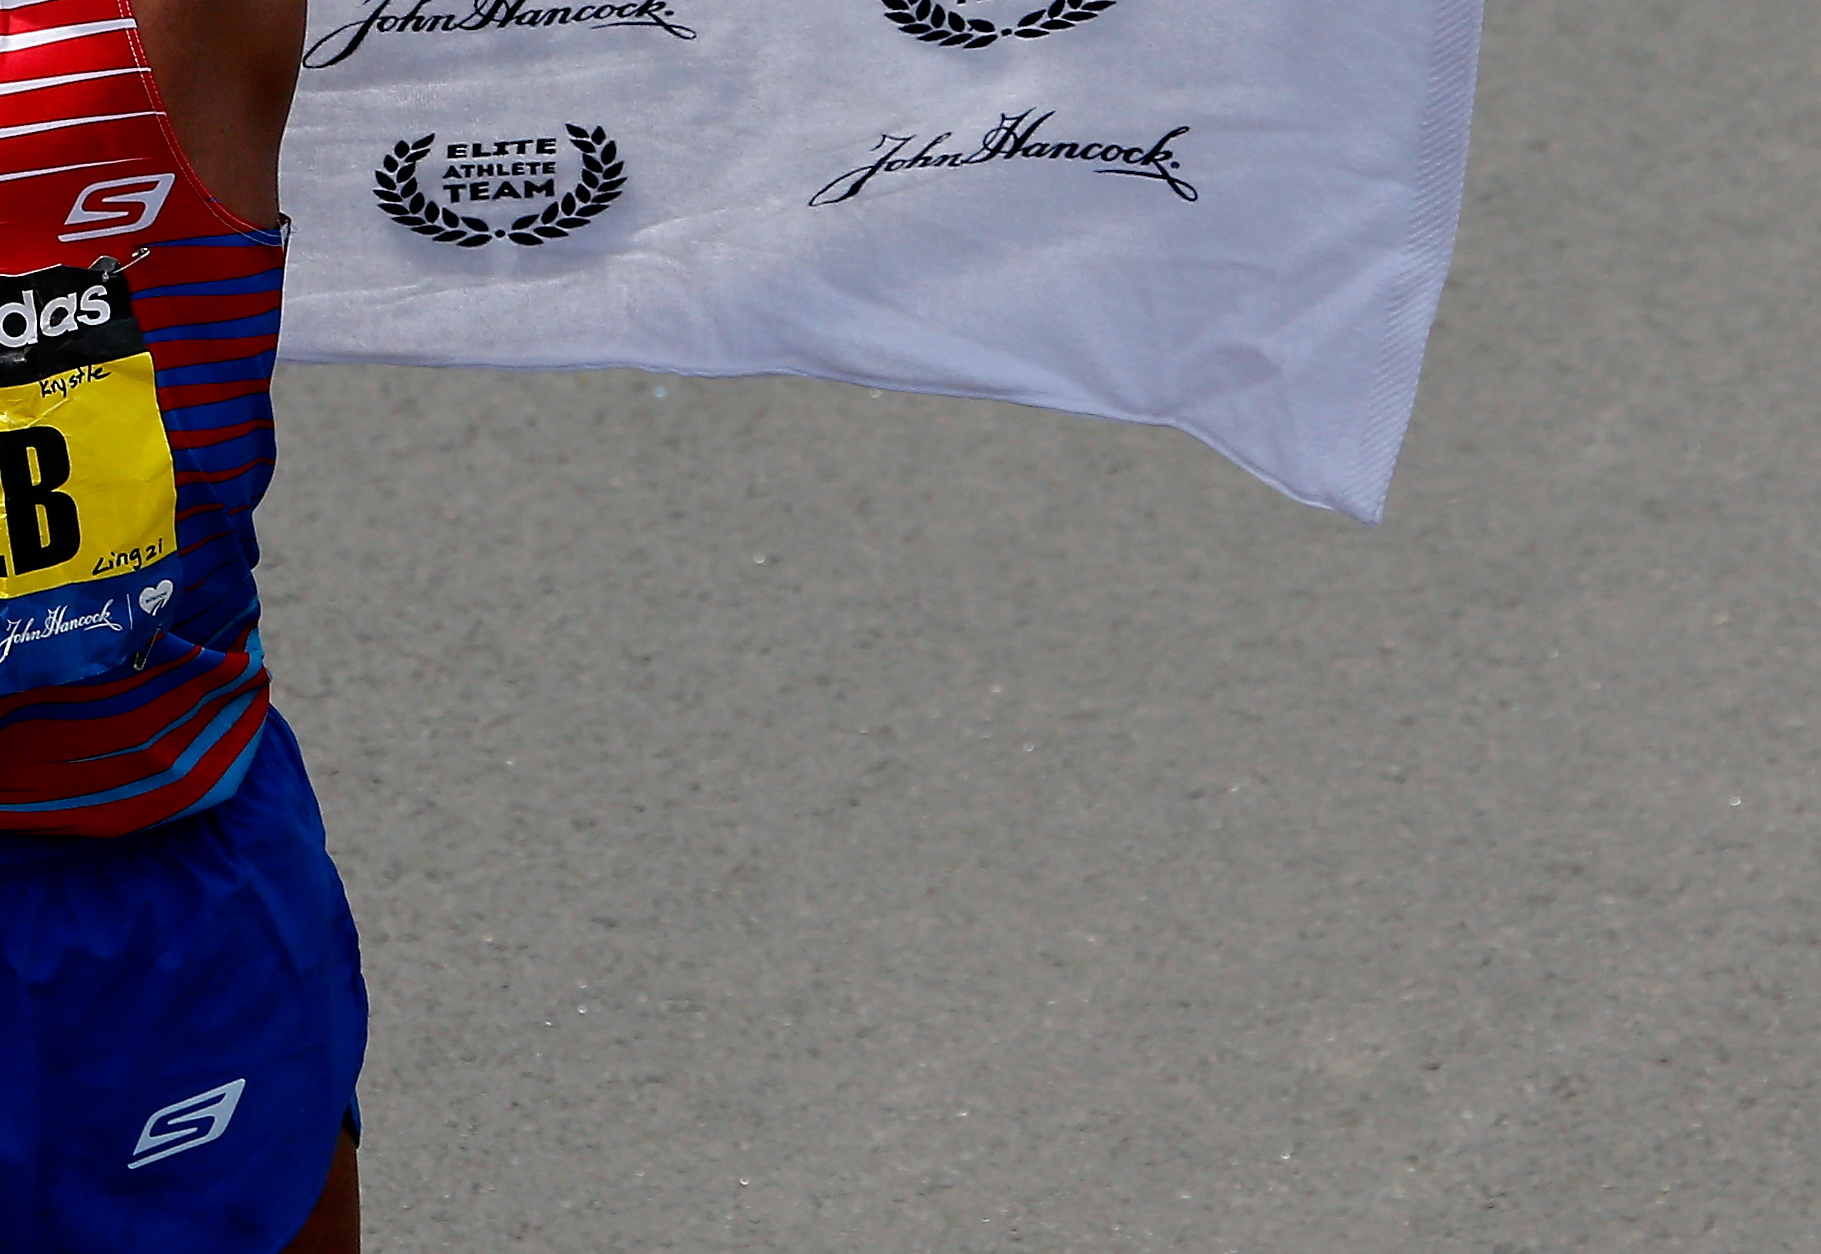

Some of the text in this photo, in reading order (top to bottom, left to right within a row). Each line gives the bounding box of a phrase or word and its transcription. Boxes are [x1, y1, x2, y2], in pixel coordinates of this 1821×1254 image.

[446, 138, 557, 159] ELITE
[442, 161, 556, 179] ATHLETE
[808, 132, 966, 207] John
[443, 179, 556, 203] TEAM
